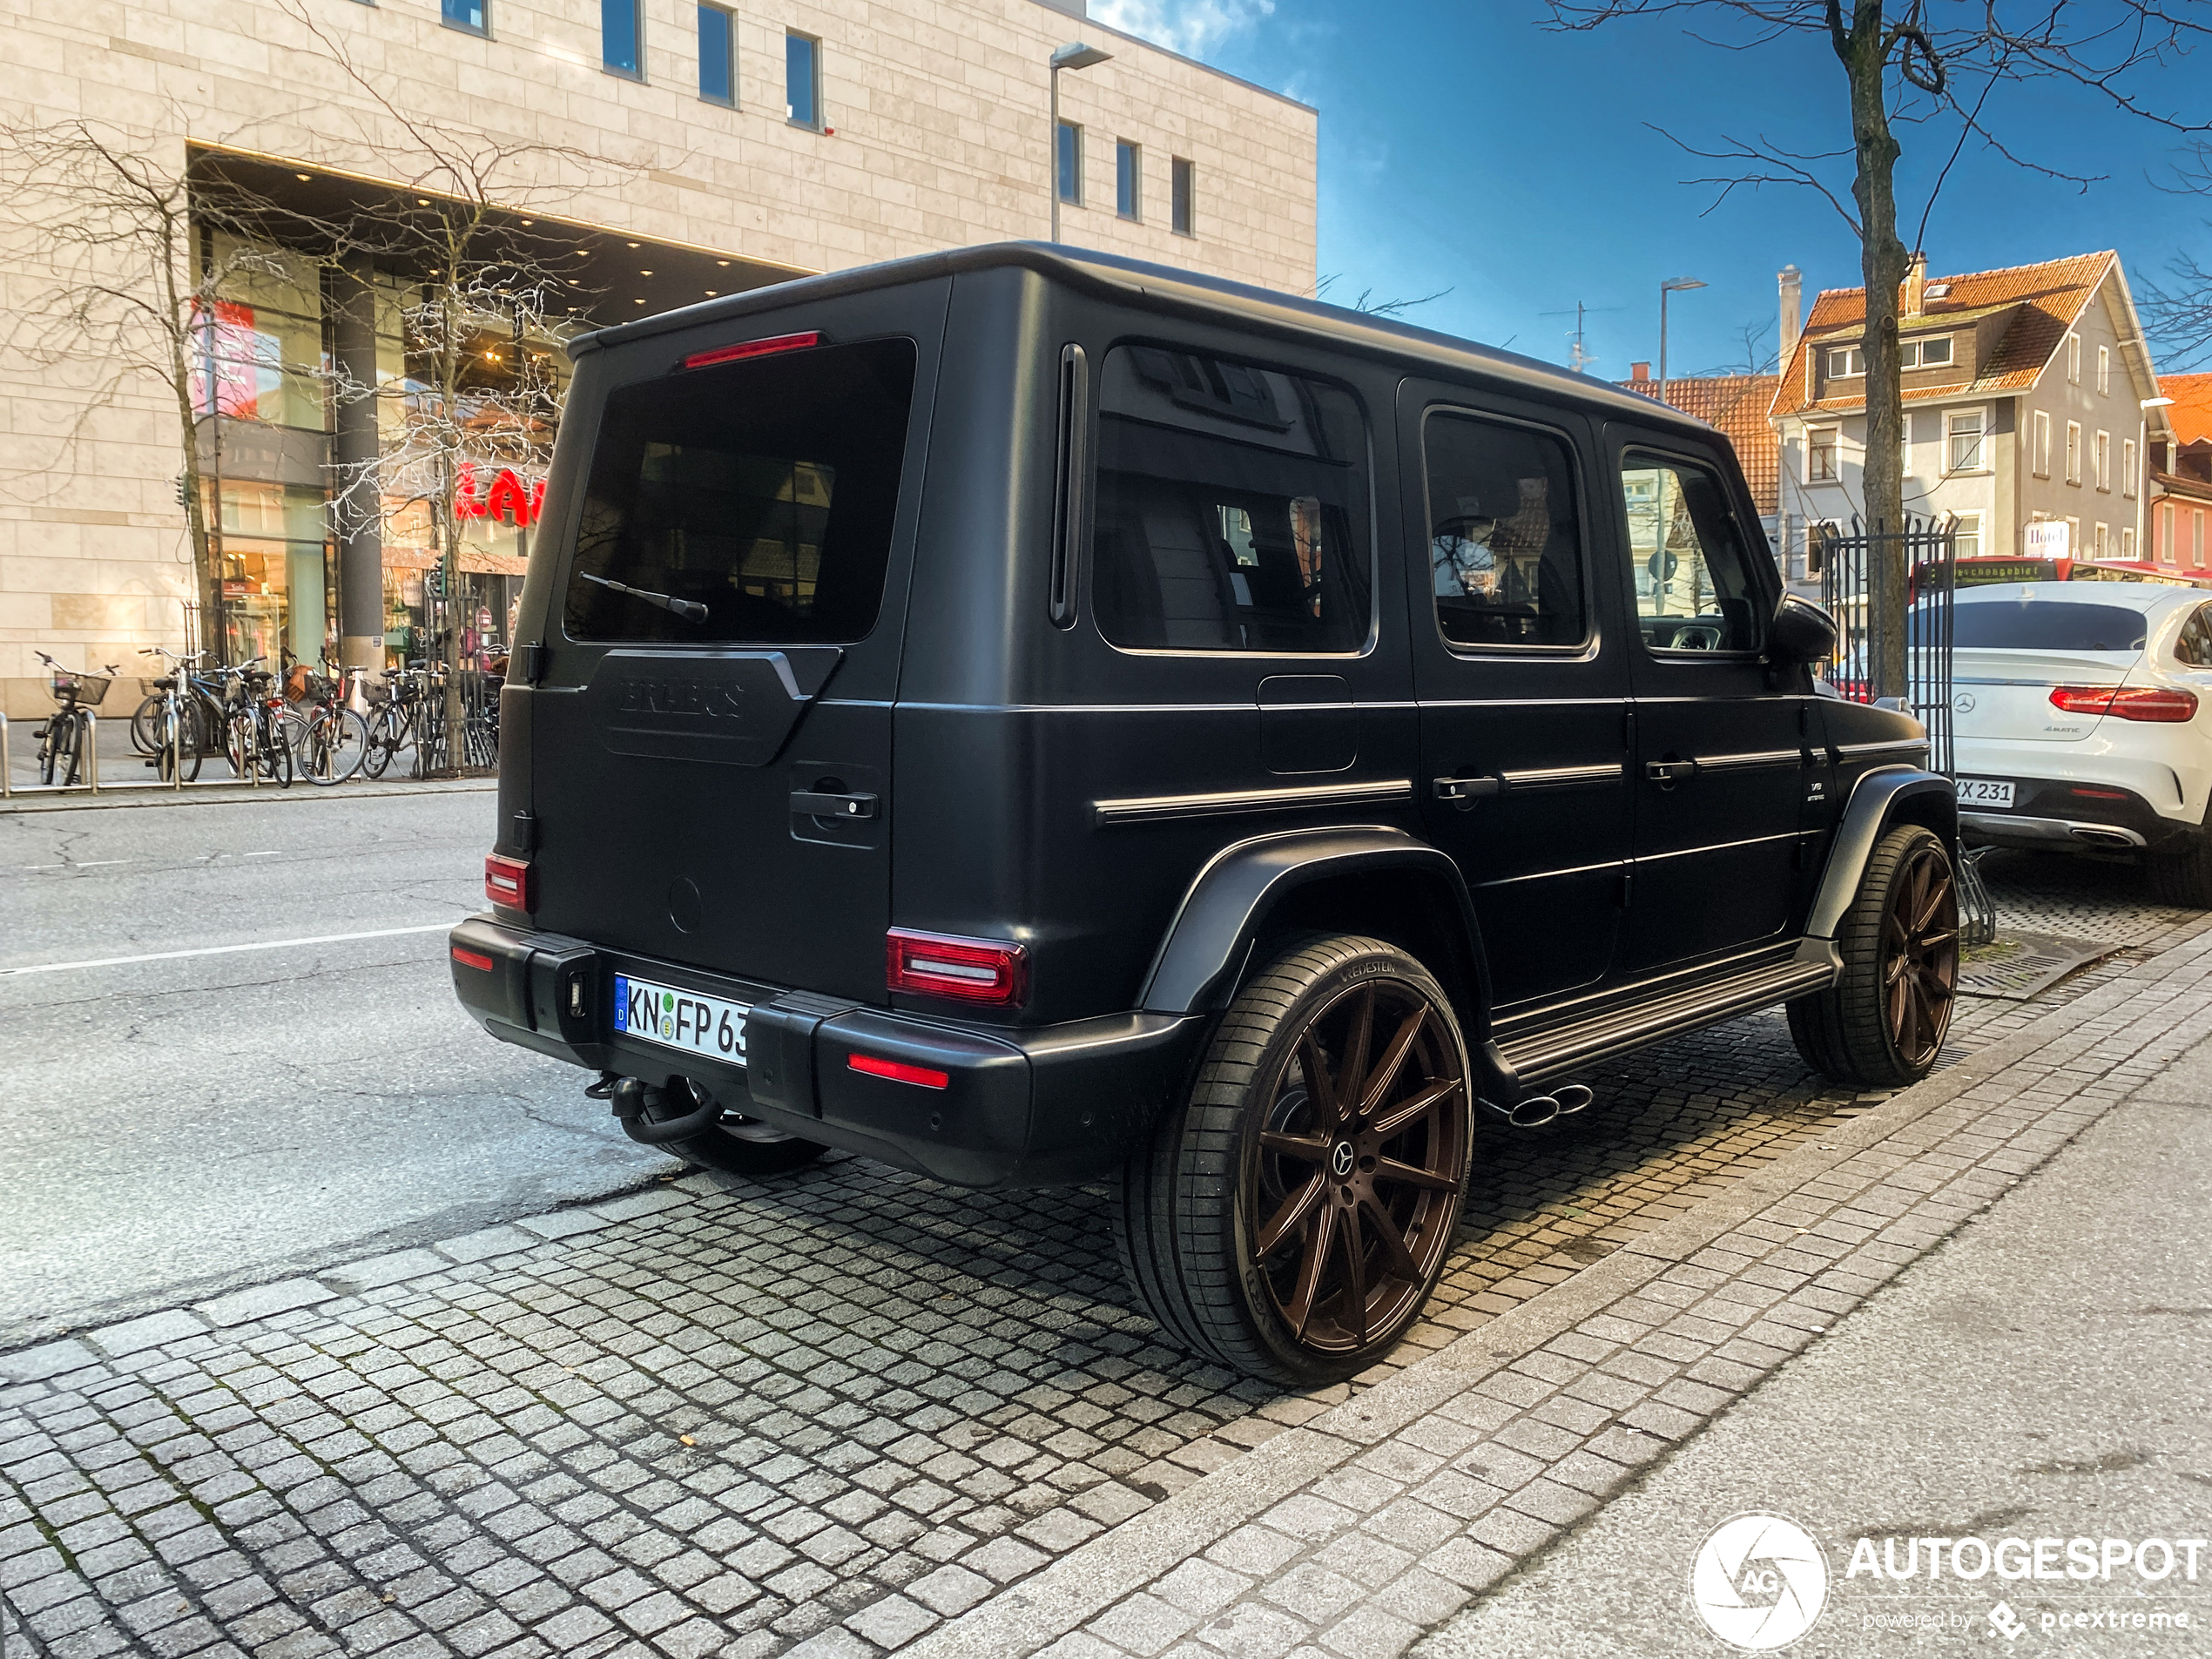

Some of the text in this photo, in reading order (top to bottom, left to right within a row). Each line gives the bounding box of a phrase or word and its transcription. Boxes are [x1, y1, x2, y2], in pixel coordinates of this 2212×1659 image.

[2031, 528, 2063, 544] Hotel
[1977, 783, 2011, 801] 231
[1339, 960, 1396, 983] VREDESTEIN
[627, 985, 659, 1035] KN
[676, 998, 711, 1046] FP
